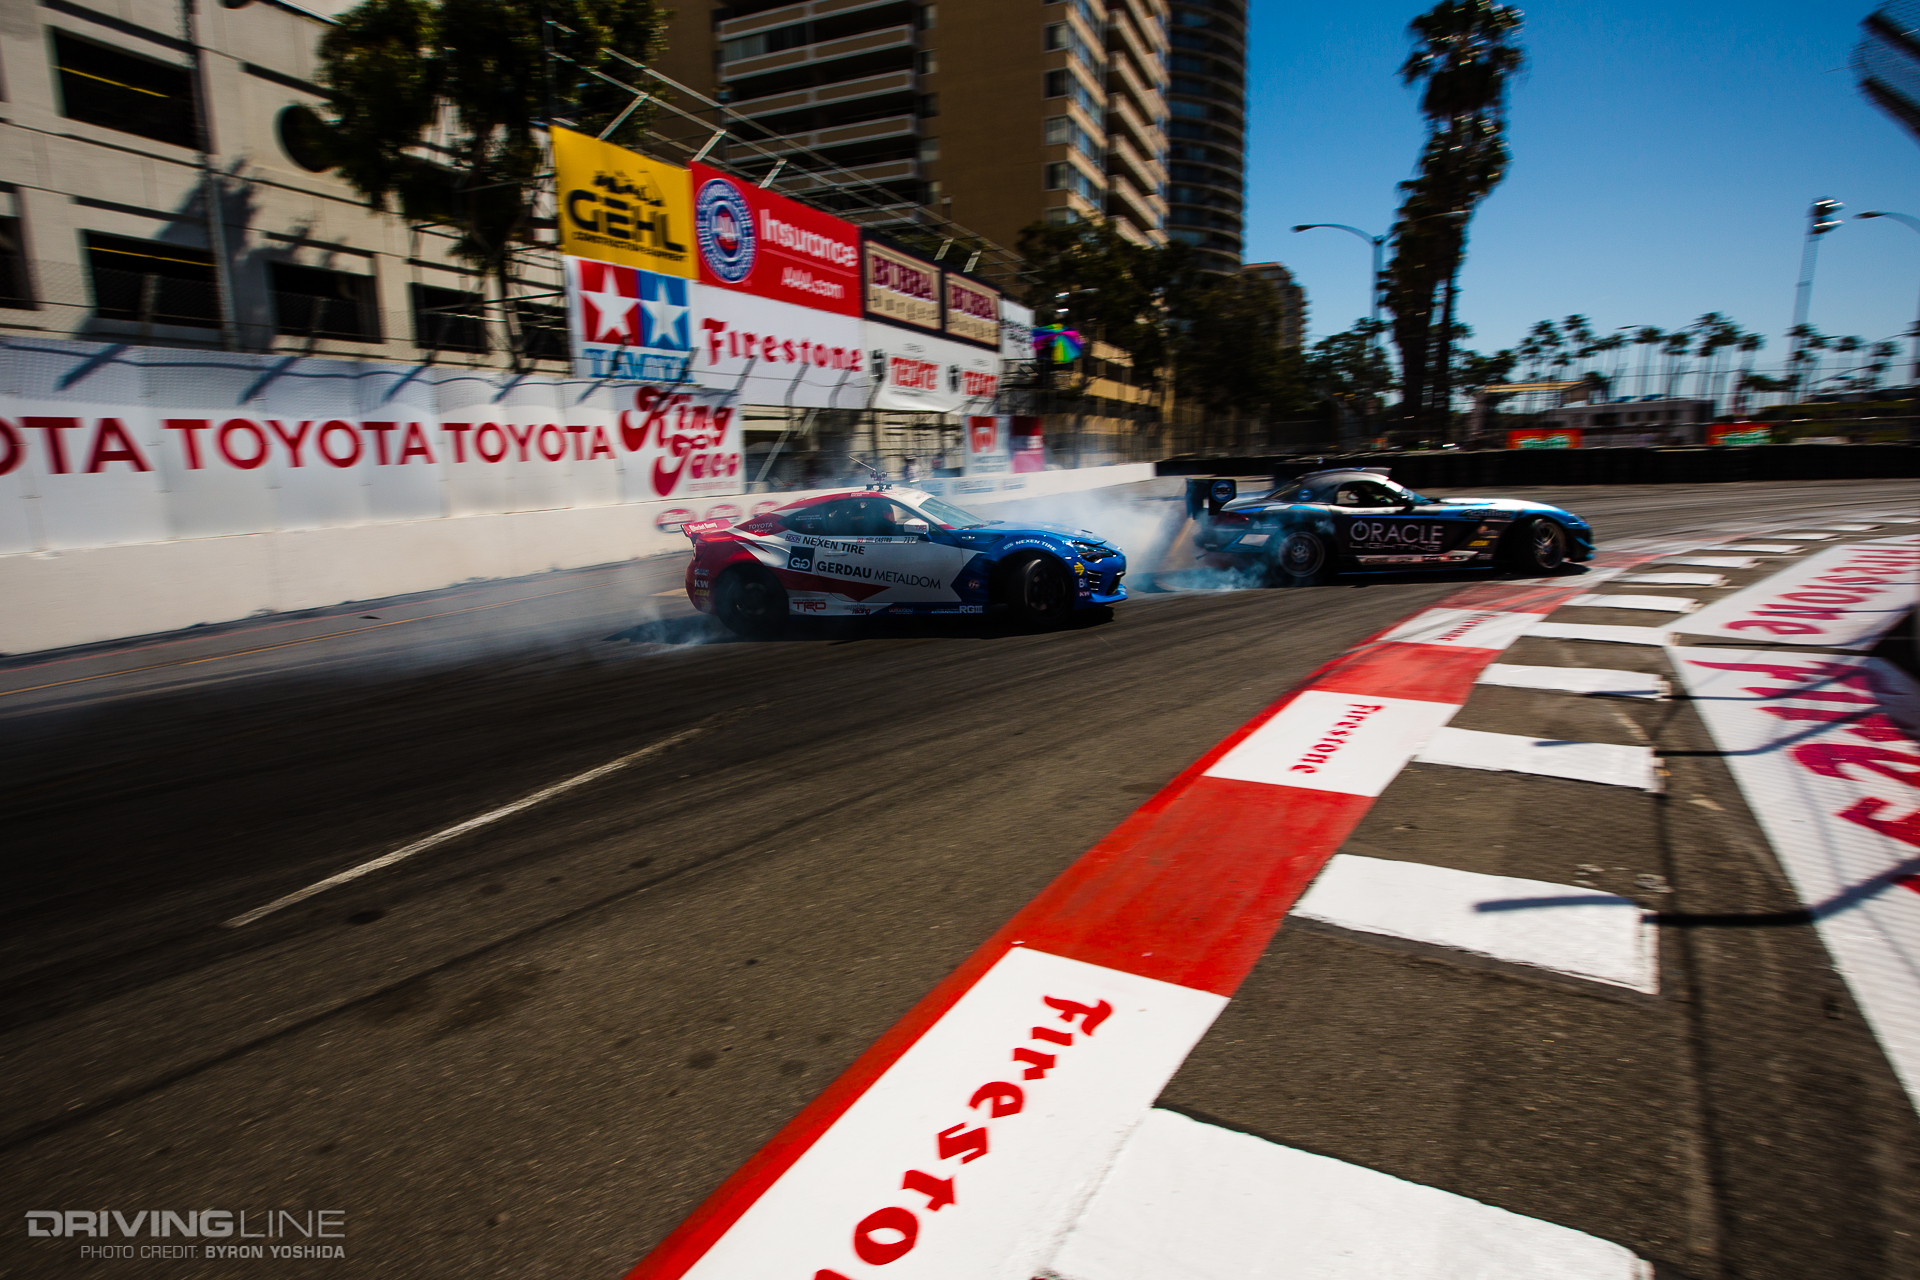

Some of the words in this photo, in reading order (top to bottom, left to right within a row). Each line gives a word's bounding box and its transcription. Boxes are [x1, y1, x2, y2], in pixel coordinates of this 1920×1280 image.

[567, 189, 688, 253] GEHL
[759, 208, 858, 267] Insurance
[700, 317, 864, 372] Firestone
[159, 417, 439, 471] TOYOTA
[439, 421, 619, 464] TOYOTA
[748, 522, 773, 530] TOYOTA
[1349, 519, 1445, 546] ORACLE
[802, 536, 840, 551] NEXEN
[841, 541, 866, 555] TIRE
[1041, 540, 1058, 552] TIRE
[1348, 541, 1443, 552] LIGHTING
[694, 579, 709, 589] KW
[816, 559, 872, 579] GERDAU
[873, 569, 941, 590] METALDOM
[792, 601, 827, 613] TRD
[1288, 703, 1386, 774] Firestone
[812, 994, 1115, 1280] Firesto
